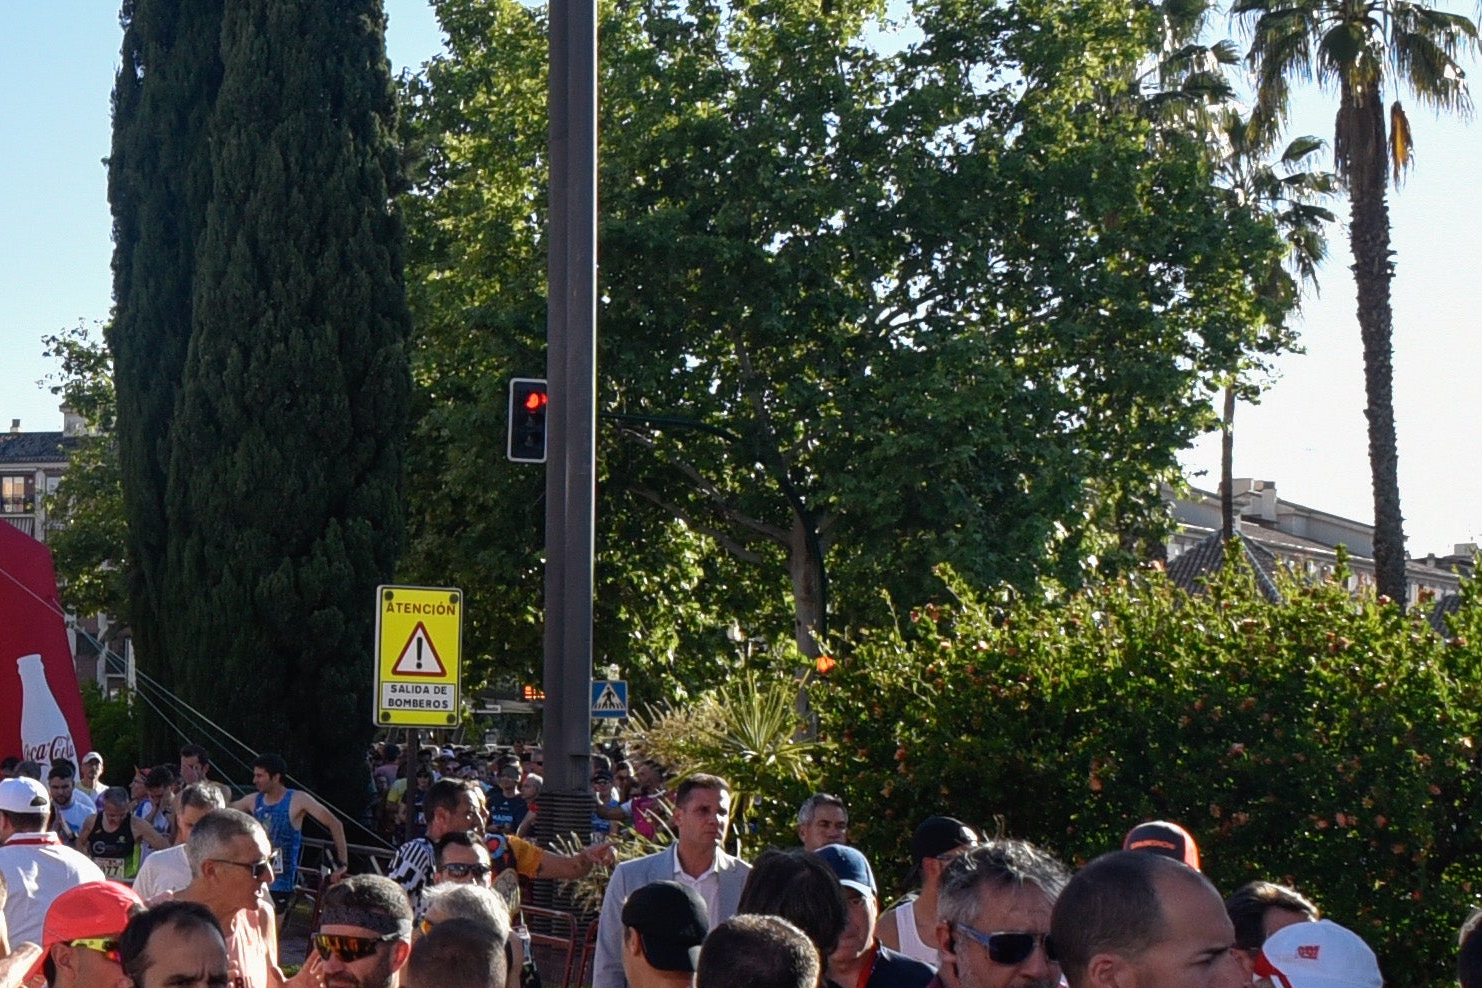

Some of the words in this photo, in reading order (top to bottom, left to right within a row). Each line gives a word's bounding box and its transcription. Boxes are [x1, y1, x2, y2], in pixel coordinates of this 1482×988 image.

[386, 602, 456, 616] ATENCIÓN
[390, 685, 430, 695] SALIDA
[433, 686, 448, 695] DE
[388, 698, 449, 709] BOMBEROS
